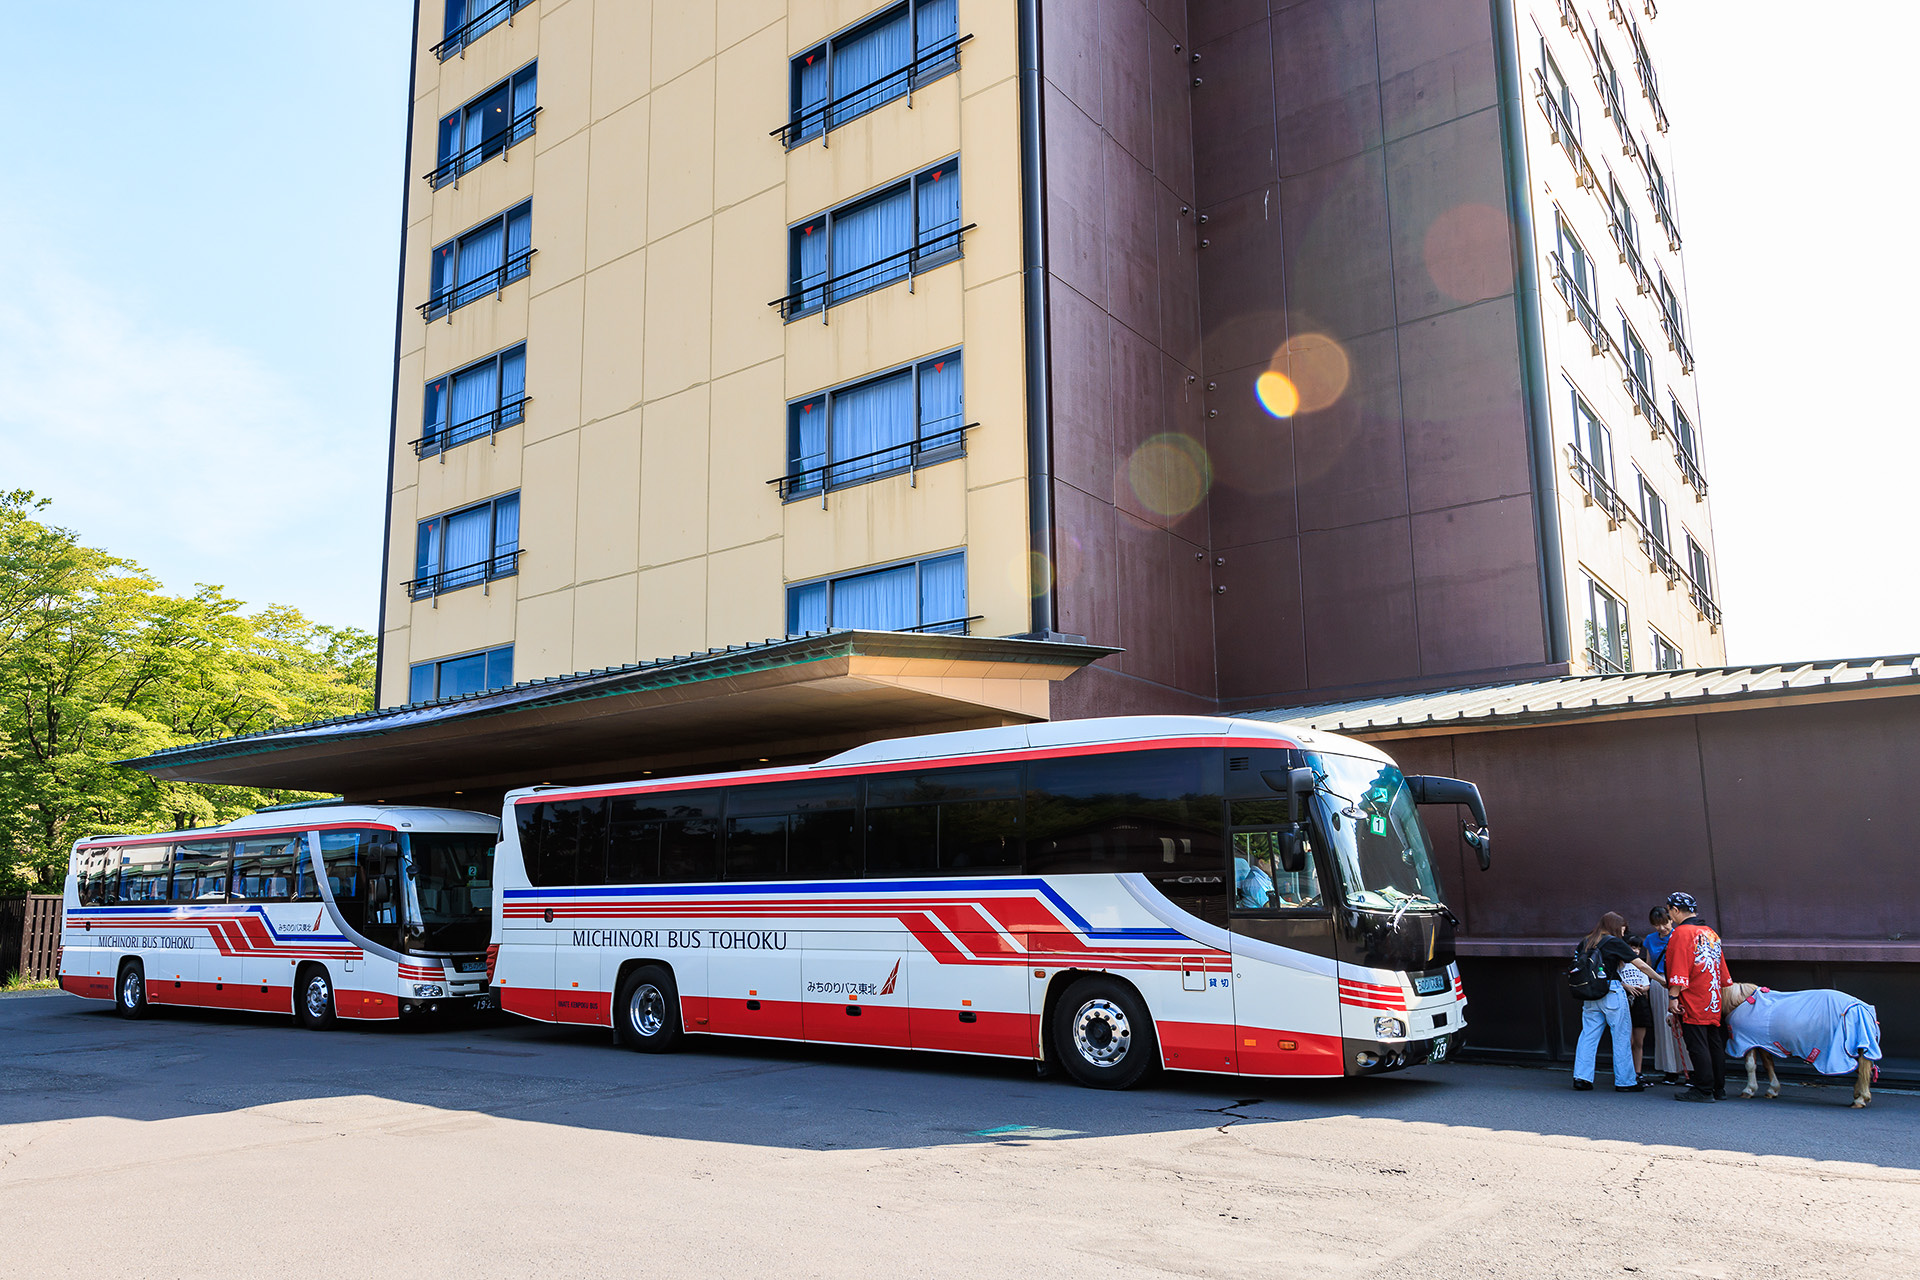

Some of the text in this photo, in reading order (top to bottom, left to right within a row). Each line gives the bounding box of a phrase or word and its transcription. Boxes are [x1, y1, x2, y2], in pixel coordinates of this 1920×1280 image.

[1177, 875, 1222, 884] GALA
[98, 936, 195, 949] MICHINORI BUS TOHOKU
[572, 930, 787, 950] MICHINORI BUS TOHOKU
[806, 981, 878, 995] みちのりバス東北
